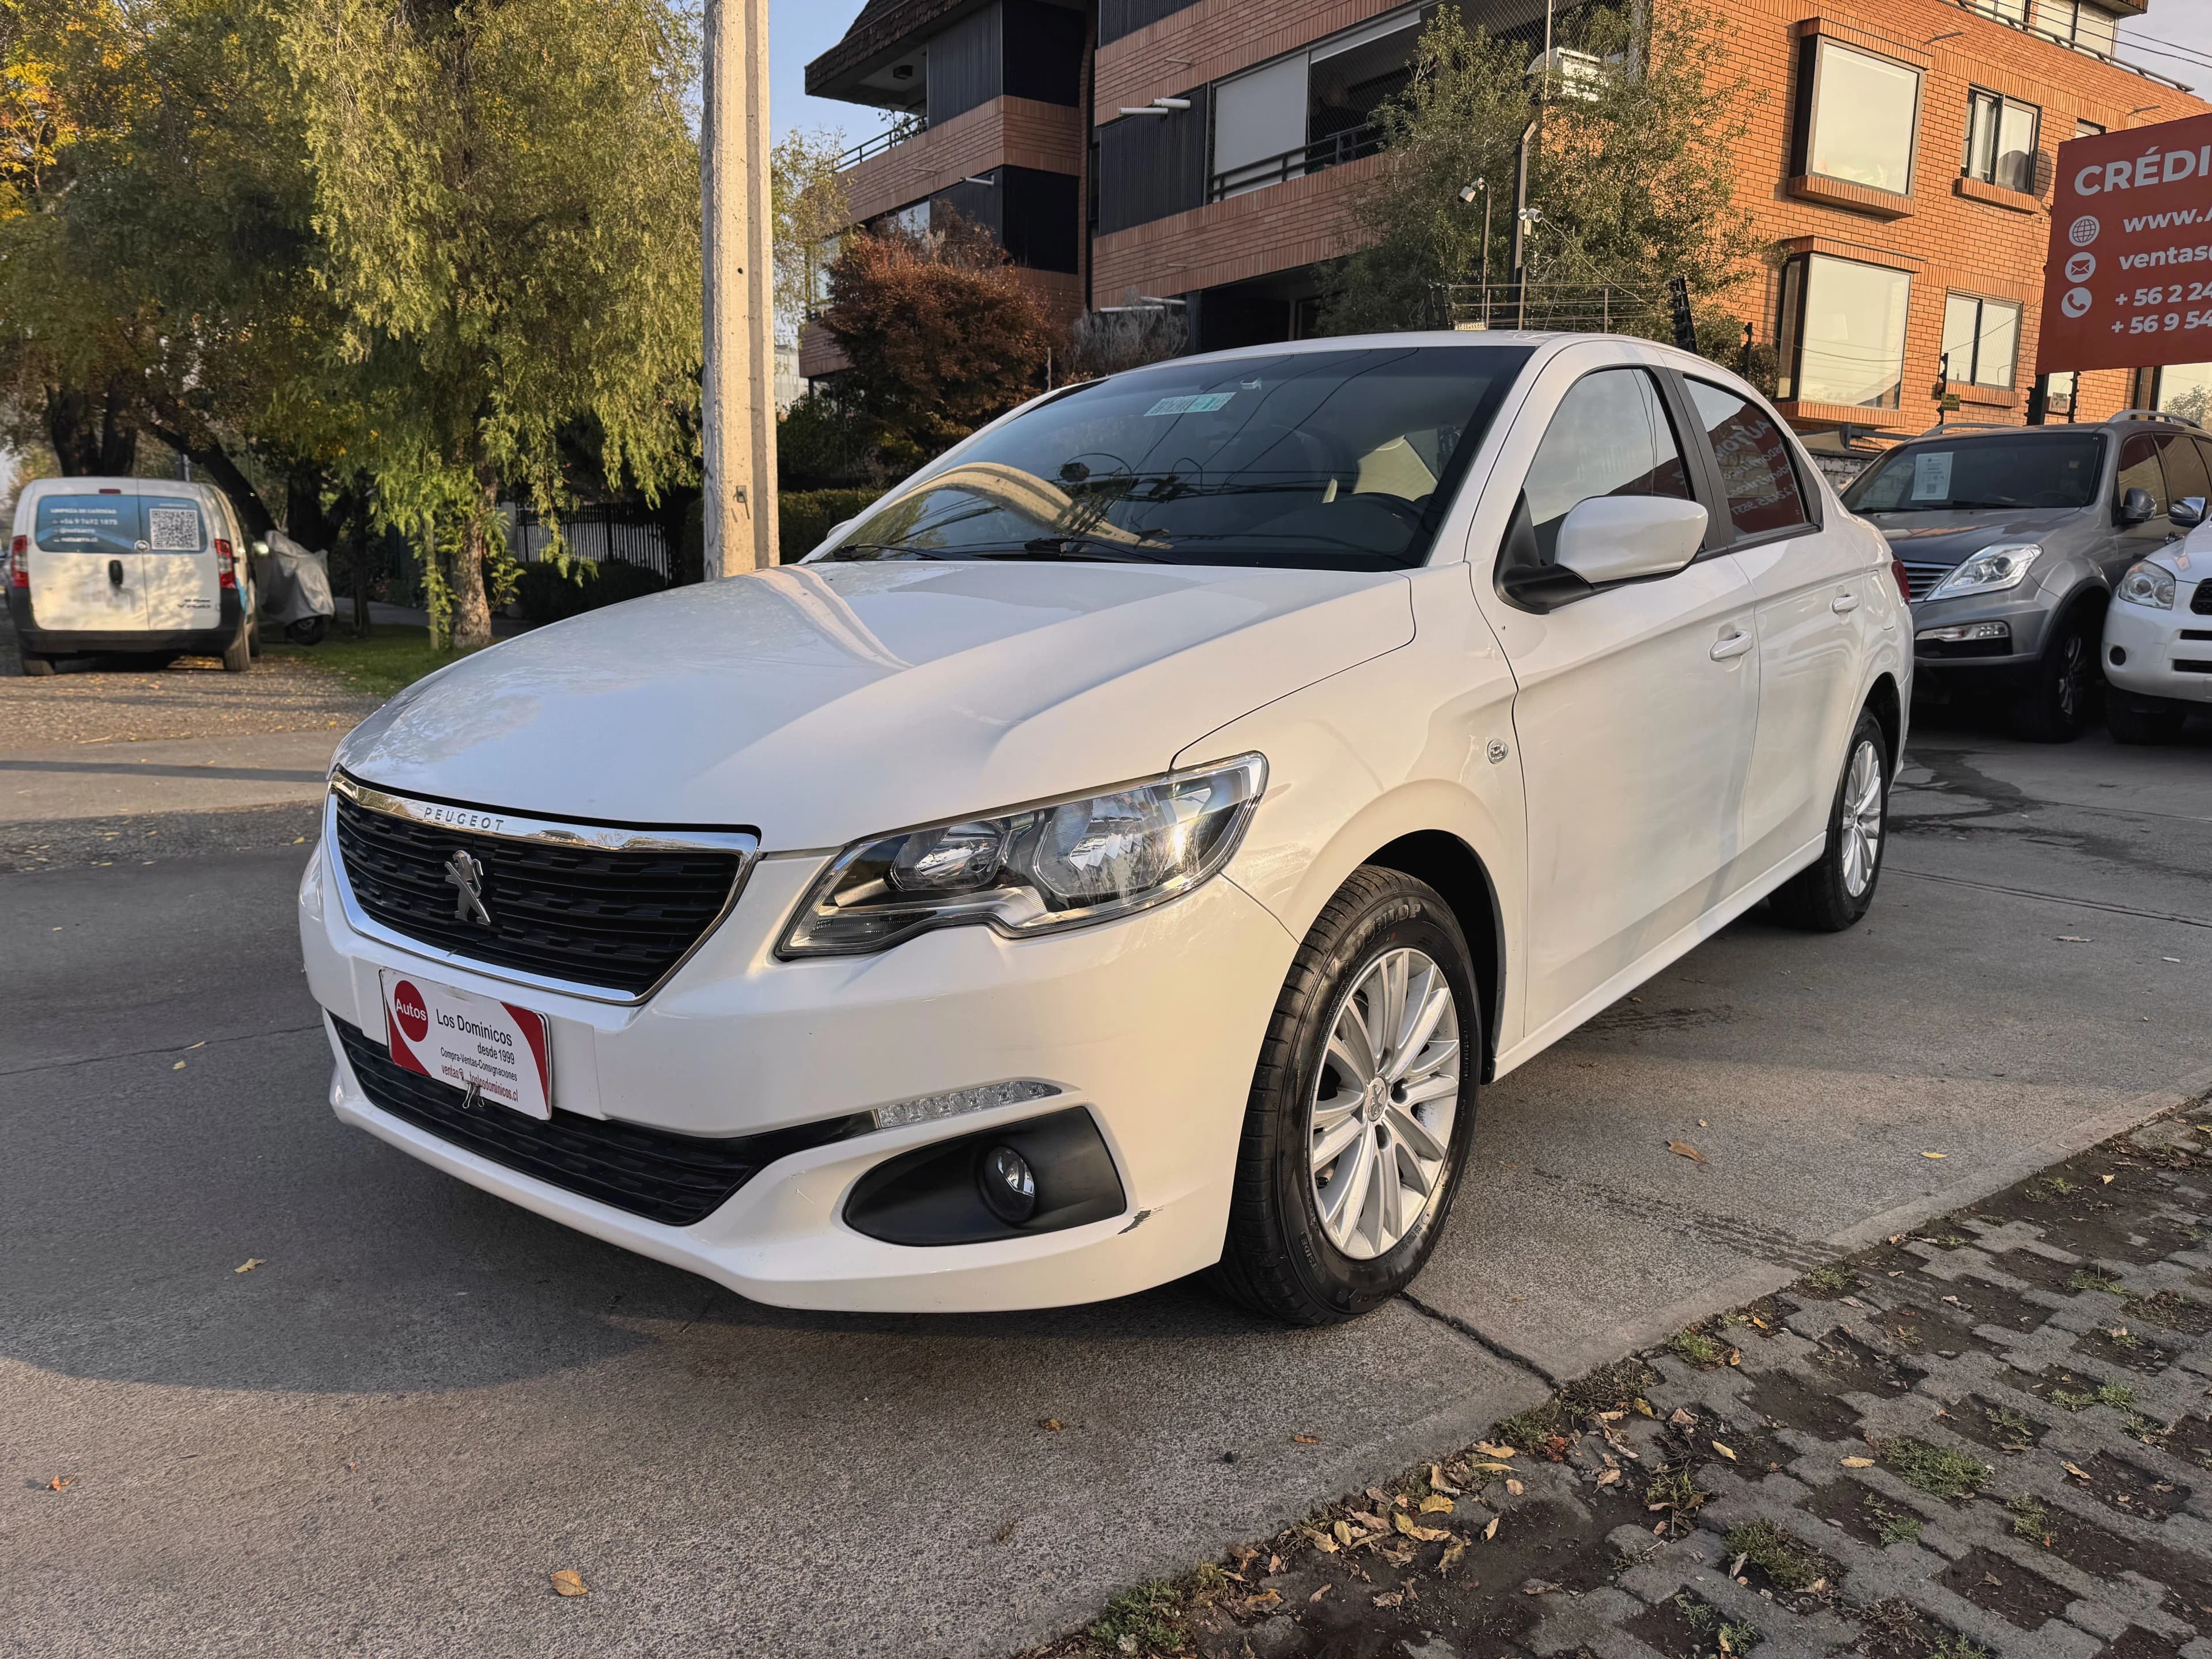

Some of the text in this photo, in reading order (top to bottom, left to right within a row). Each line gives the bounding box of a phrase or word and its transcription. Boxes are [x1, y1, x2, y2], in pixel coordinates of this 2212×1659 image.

[2074, 145, 2211, 196] CRÉDI
[2119, 245, 2212, 270] ventas
[2133, 287, 2163, 306] 56
[2167, 285, 2183, 302] 2
[2129, 315, 2159, 334] 56
[2164, 313, 2180, 331] 9
[424, 807, 504, 831] PEUGEOT
[396, 998, 427, 1021] Autos
[436, 1008, 513, 1046] Los Dominicos
[478, 1042, 515, 1065] desde 1999
